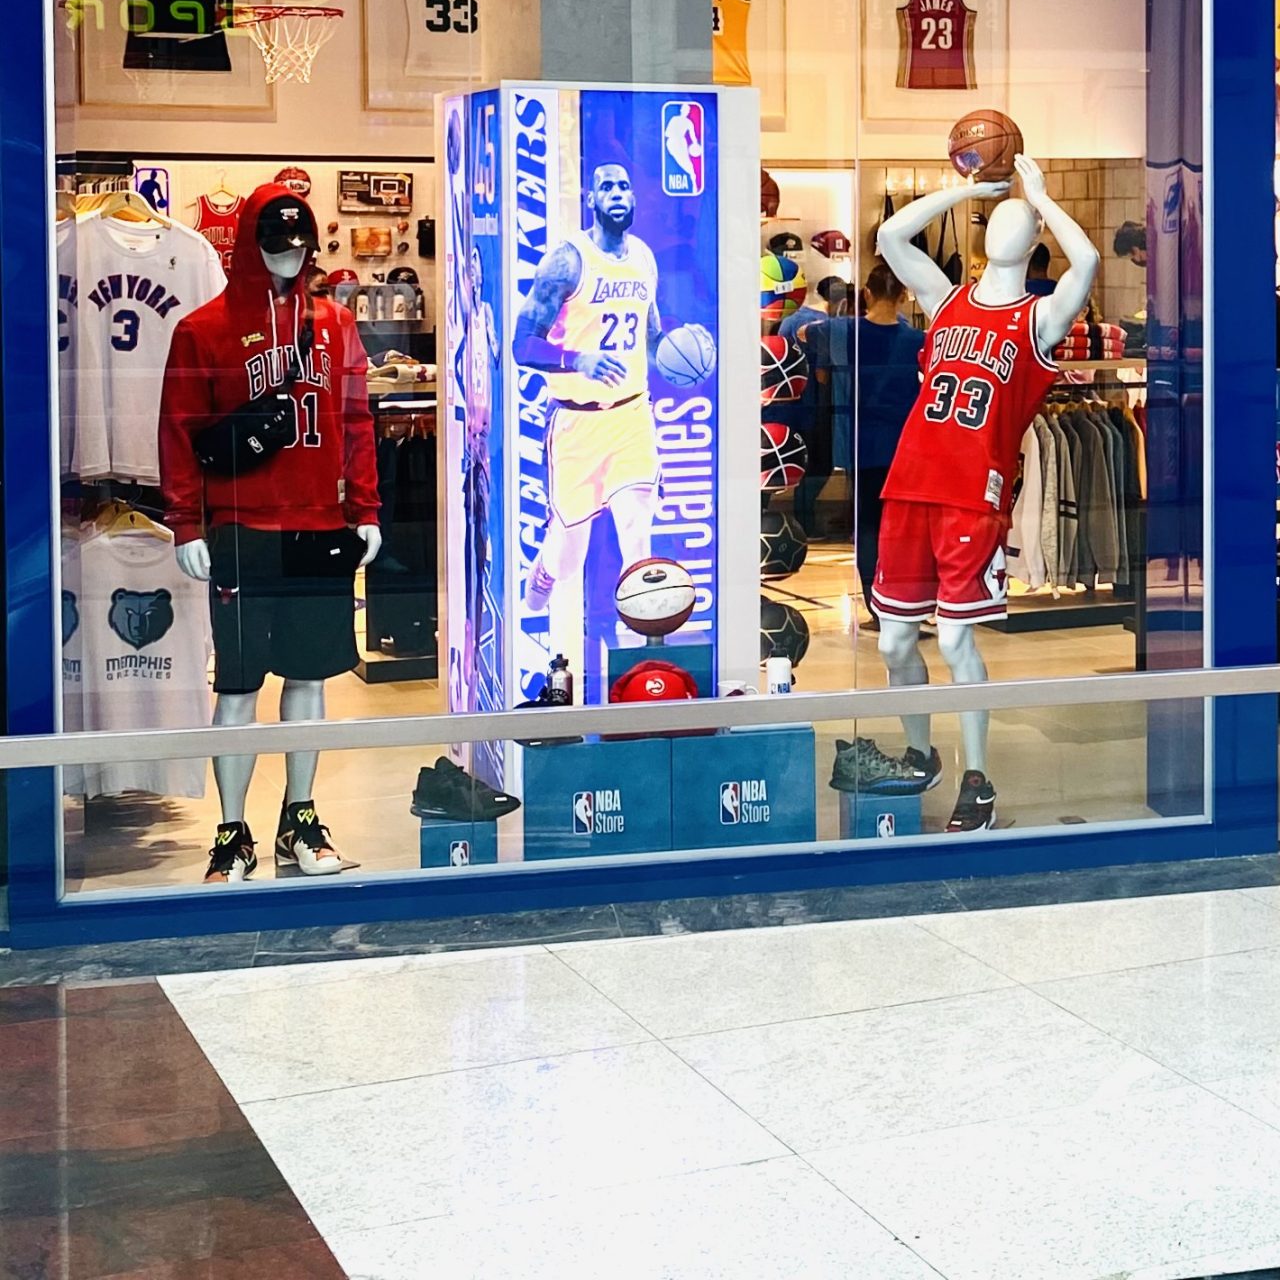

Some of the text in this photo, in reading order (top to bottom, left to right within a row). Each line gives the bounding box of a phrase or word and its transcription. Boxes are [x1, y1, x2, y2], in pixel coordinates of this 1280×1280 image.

[920, 17, 953, 50] 23
[515, 93, 548, 298] AKERS
[669, 173, 688, 191] NBA
[88, 274, 122, 312] NEW
[126, 274, 181, 319] YORK
[590, 277, 649, 304] LAKERS
[110, 309, 141, 352] 3
[599, 313, 639, 351] 23
[928, 325, 1018, 384] BULLS
[924, 372, 994, 430] 33
[652, 396, 713, 547] James
[106, 655, 172, 671] MEMPHIS
[106, 670, 172, 681] GRIZZLIES
[595, 790, 621, 812] NBA
[742, 780, 766, 801] NBA
[595, 814, 624, 834] Store
[742, 802, 770, 823] Store
